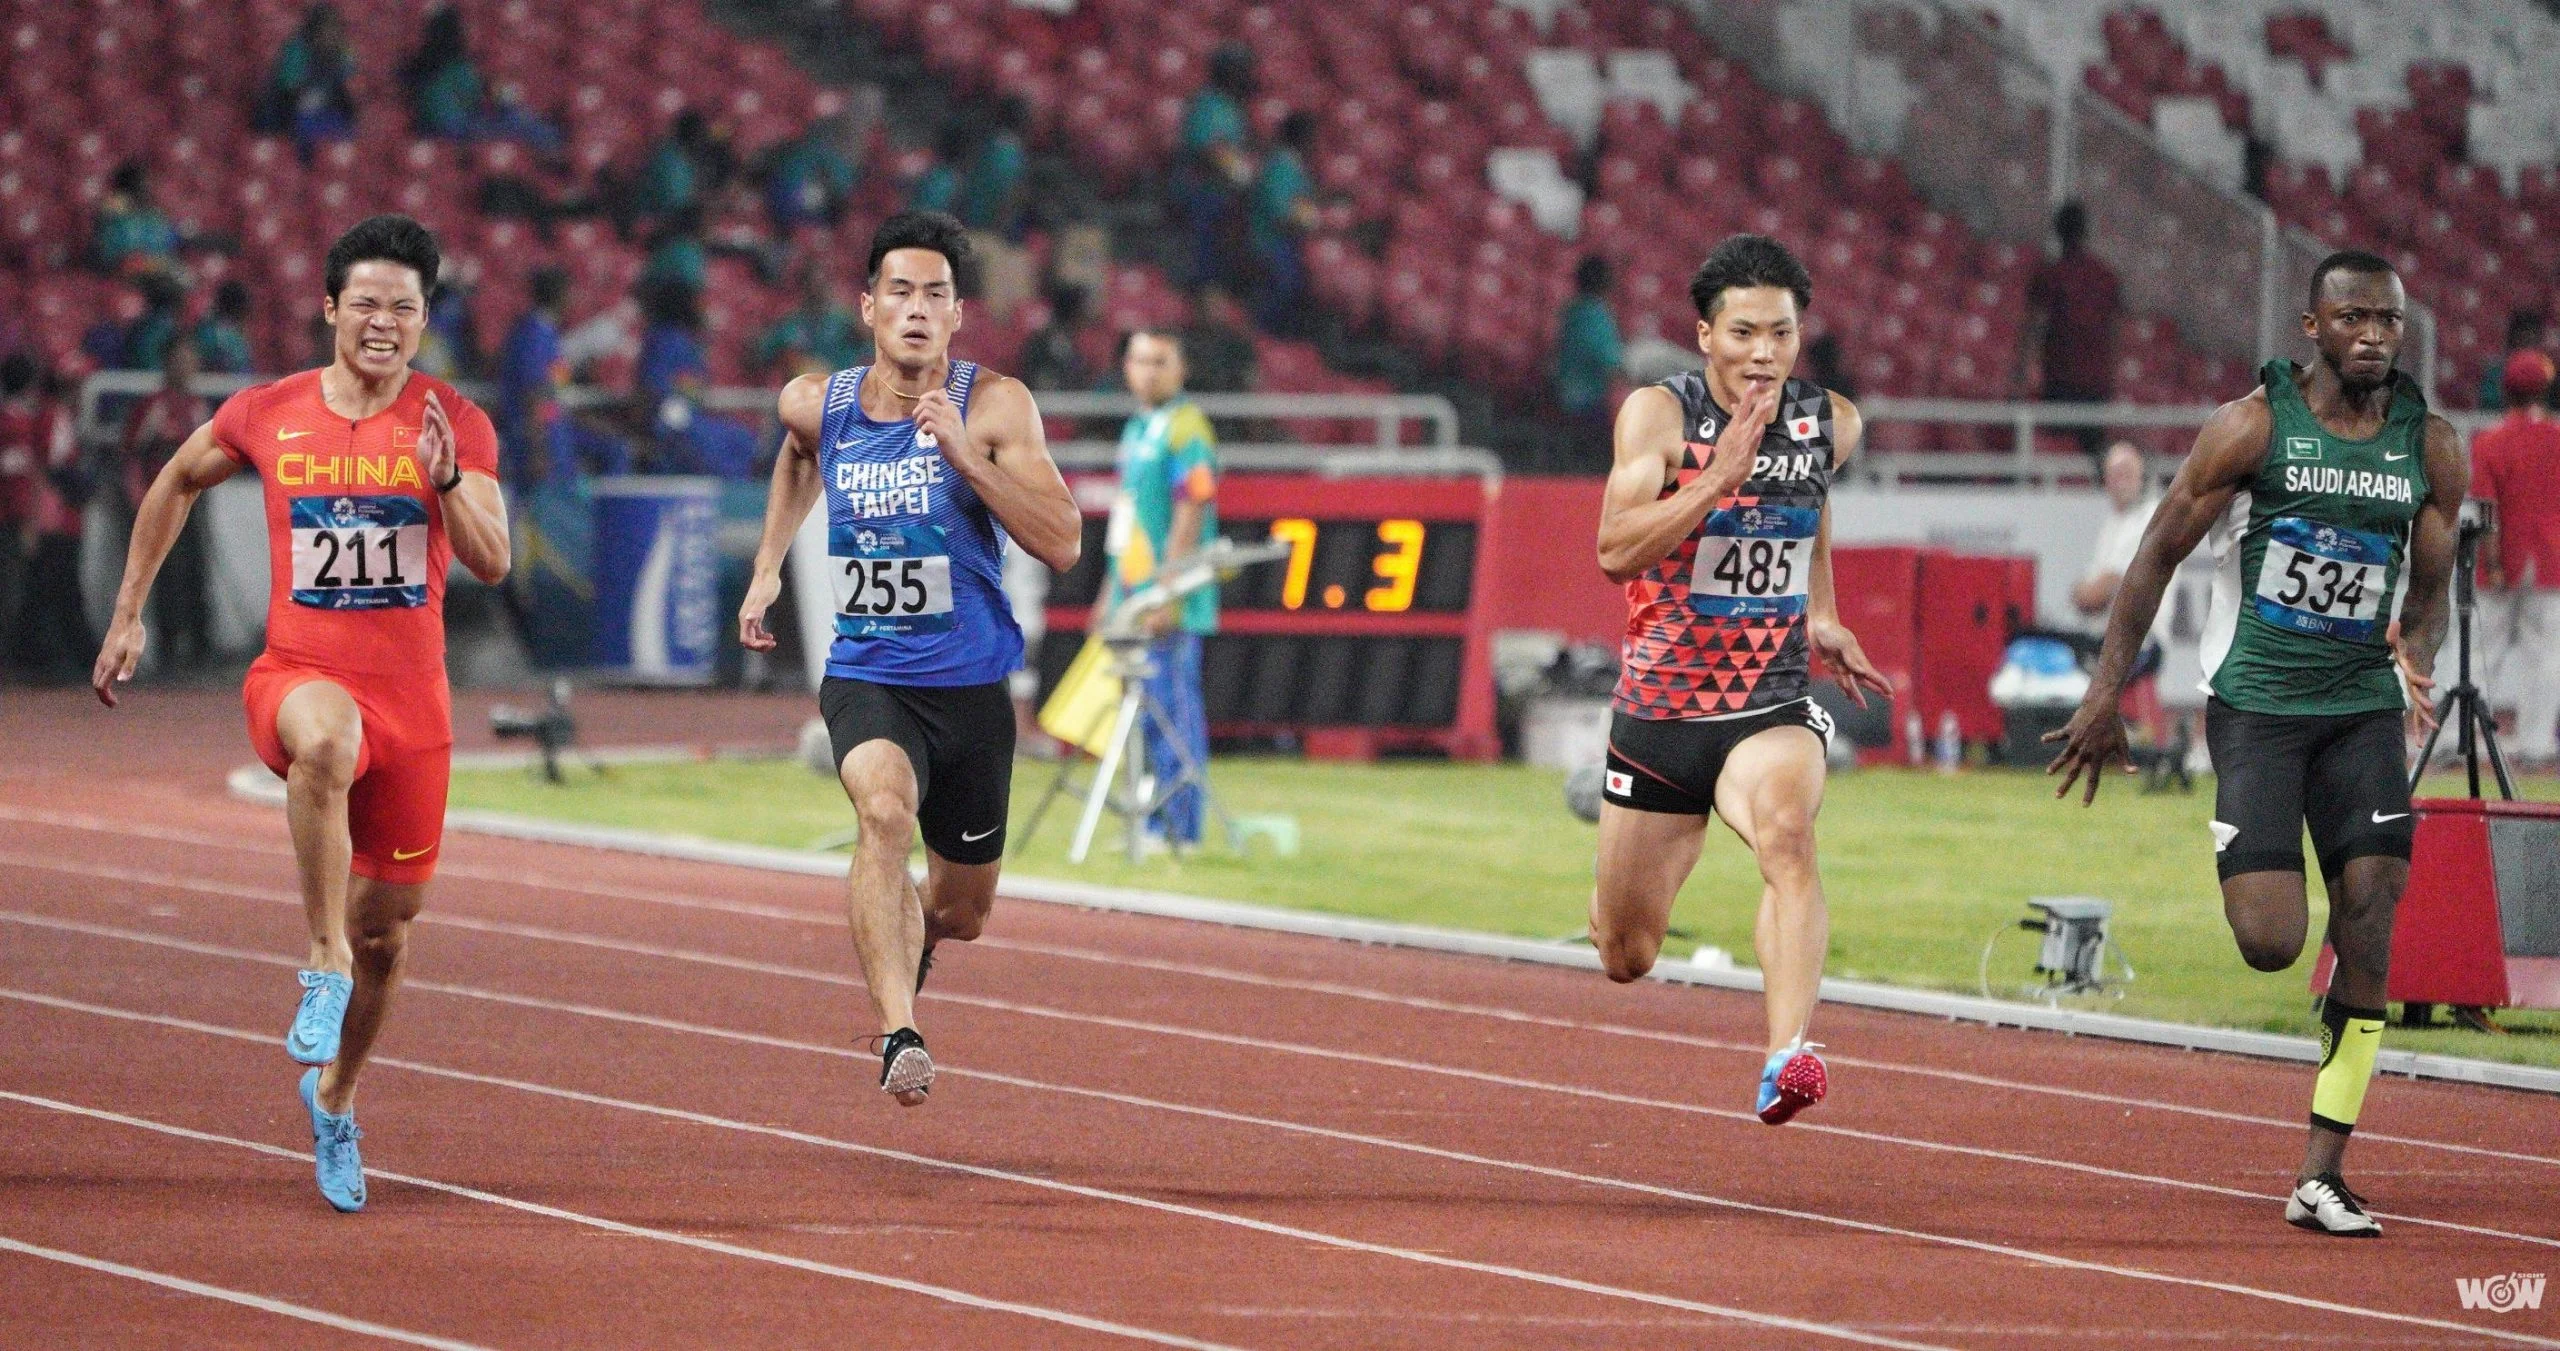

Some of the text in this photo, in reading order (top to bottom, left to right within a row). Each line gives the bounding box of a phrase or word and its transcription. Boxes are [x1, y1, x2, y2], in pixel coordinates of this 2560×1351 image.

[277, 453, 422, 489] CHINA
[837, 455, 943, 491] CHINESE
[1747, 453, 1813, 482] PAN
[2285, 465, 2412, 504] SAUDI ARABIA
[848, 486, 929, 520] TAIPEI
[313, 530, 405, 587] 211
[1713, 539, 1798, 596] 485
[845, 559, 927, 615] 255
[2277, 550, 2368, 617] 534
[2308, 618, 2333, 633] BNI
